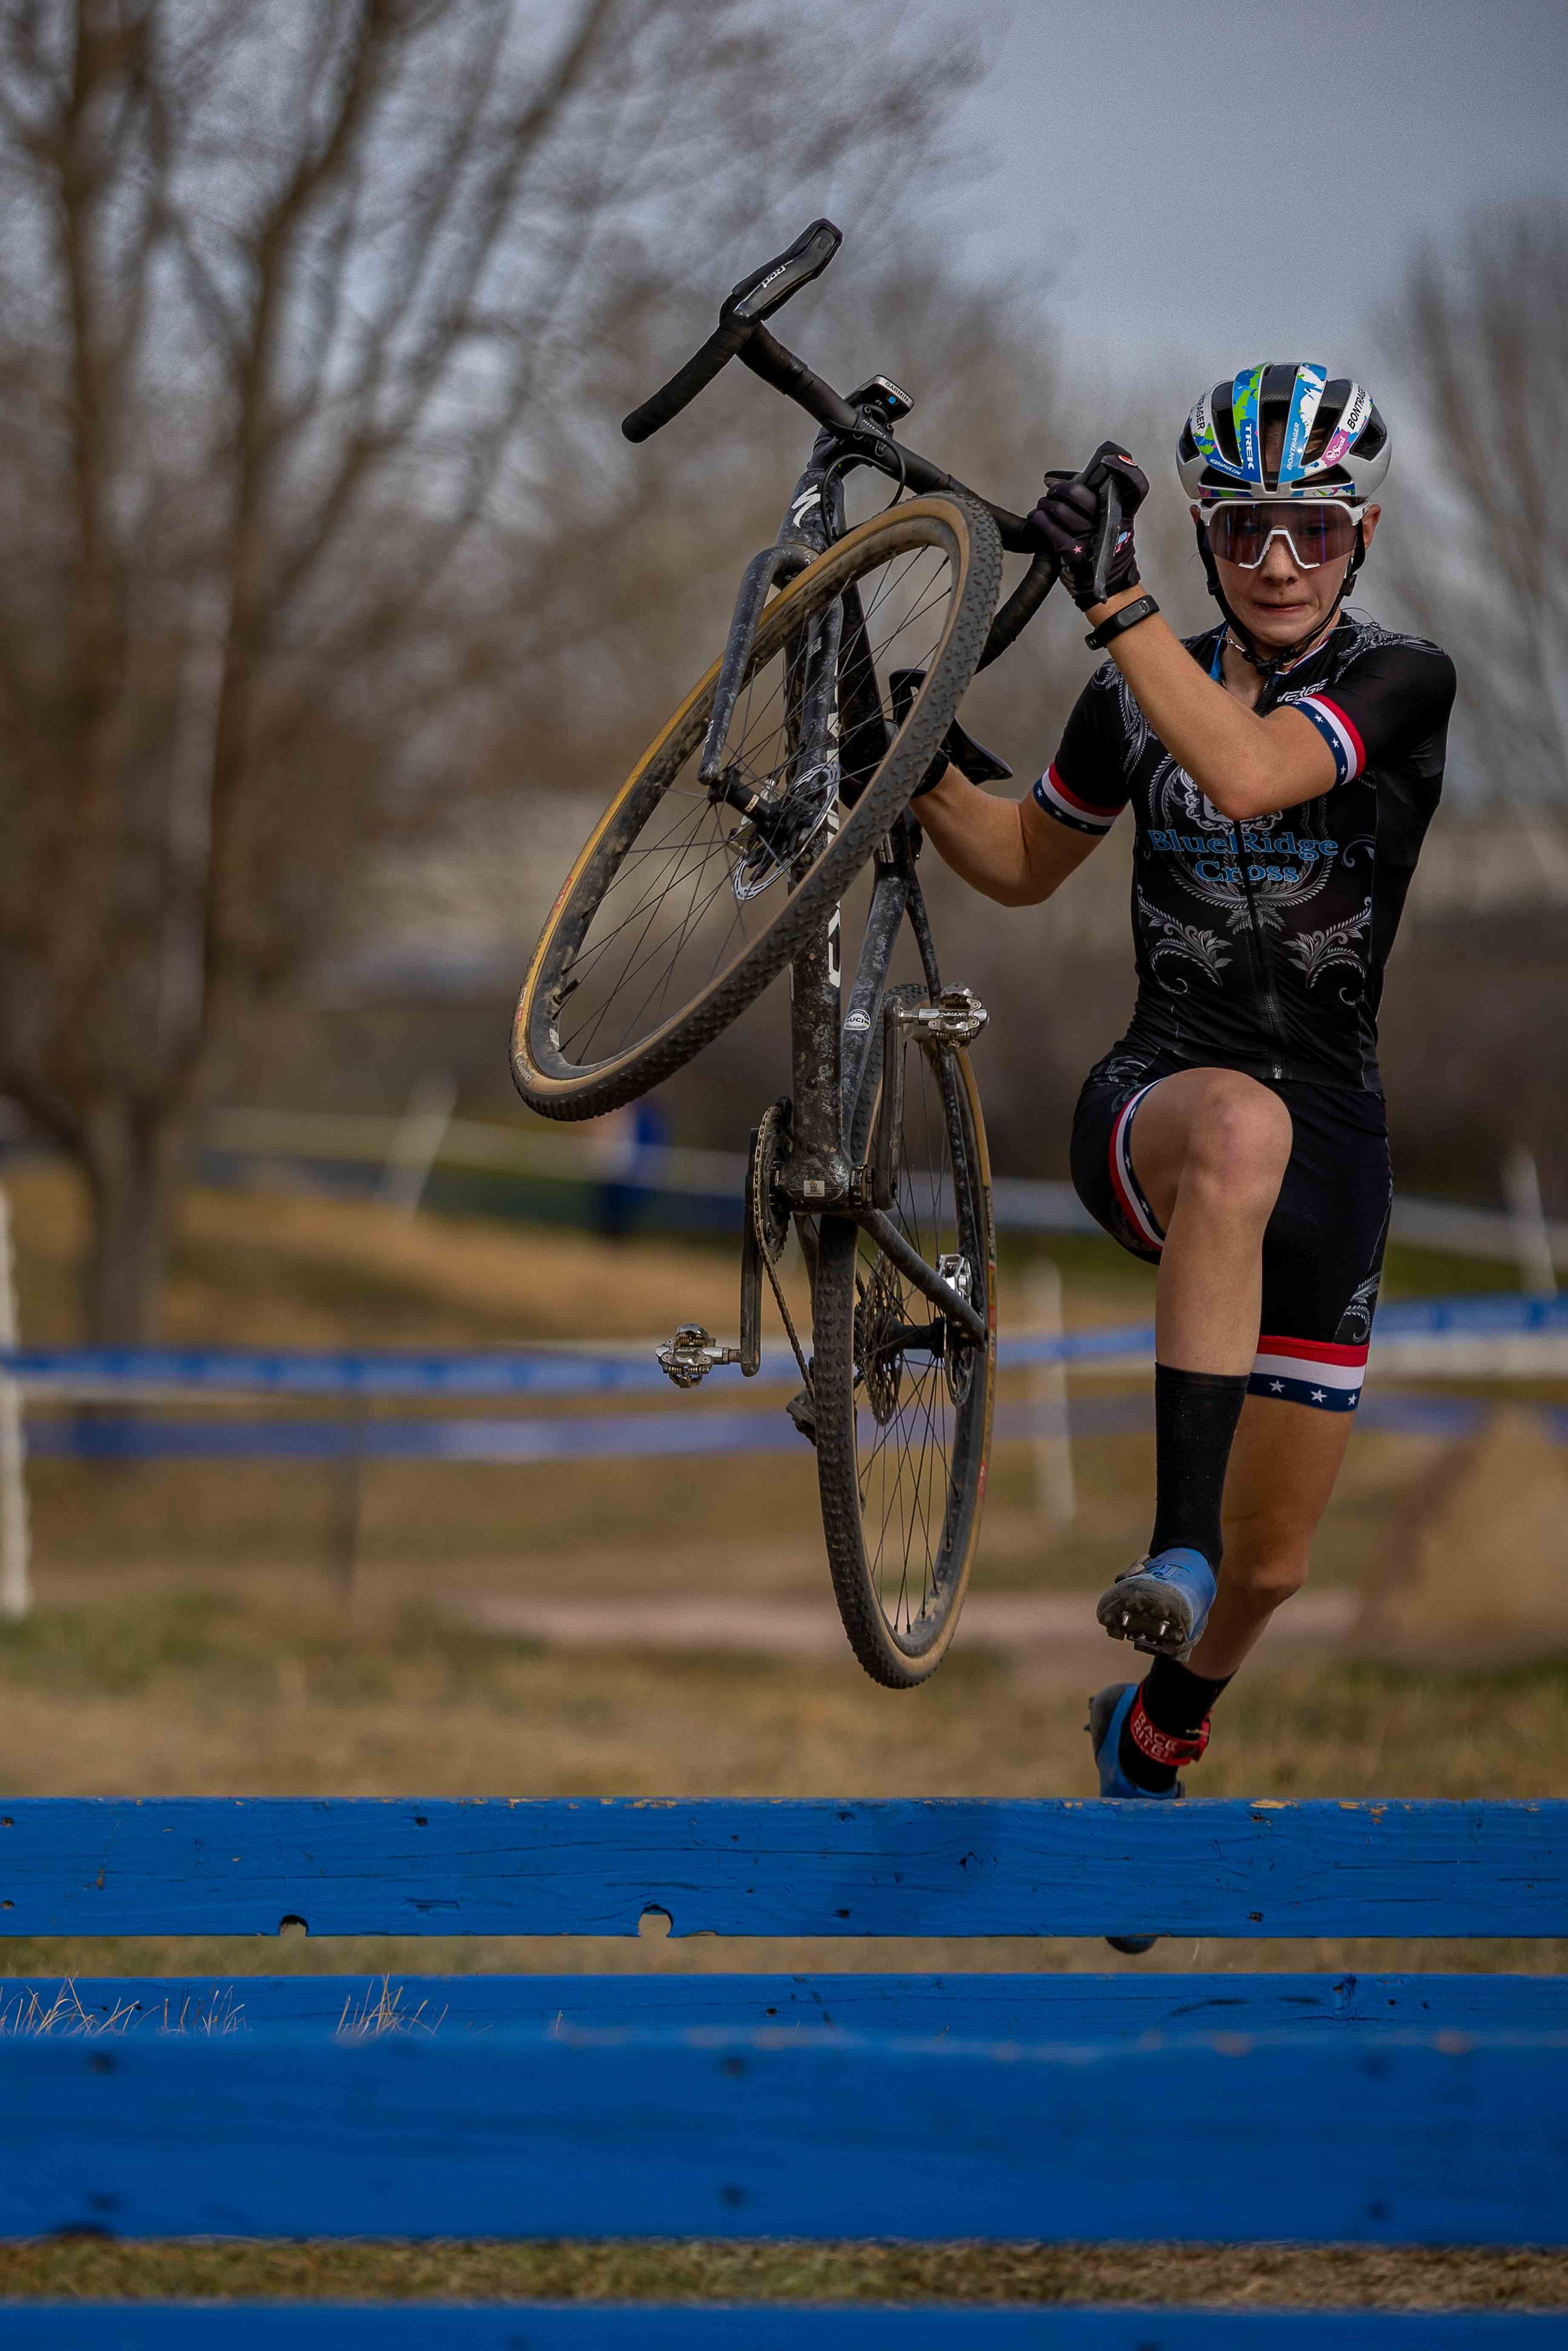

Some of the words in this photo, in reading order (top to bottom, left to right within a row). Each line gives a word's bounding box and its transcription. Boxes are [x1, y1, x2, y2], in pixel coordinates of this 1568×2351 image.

[886, 381, 909, 402] GARMIN
[1245, 423, 1255, 470] TREK
[1286, 422, 1300, 471] BONTRAGER
[1209, 458, 1242, 475] VCGRAPHIX.COM
[1276, 677, 1329, 703] VERGE
[1148, 829, 1228, 853] Blue
[1226, 830, 1338, 861] Ridge
[1195, 860, 1299, 883] Cross
[1138, 1711, 1178, 1752] RACE
